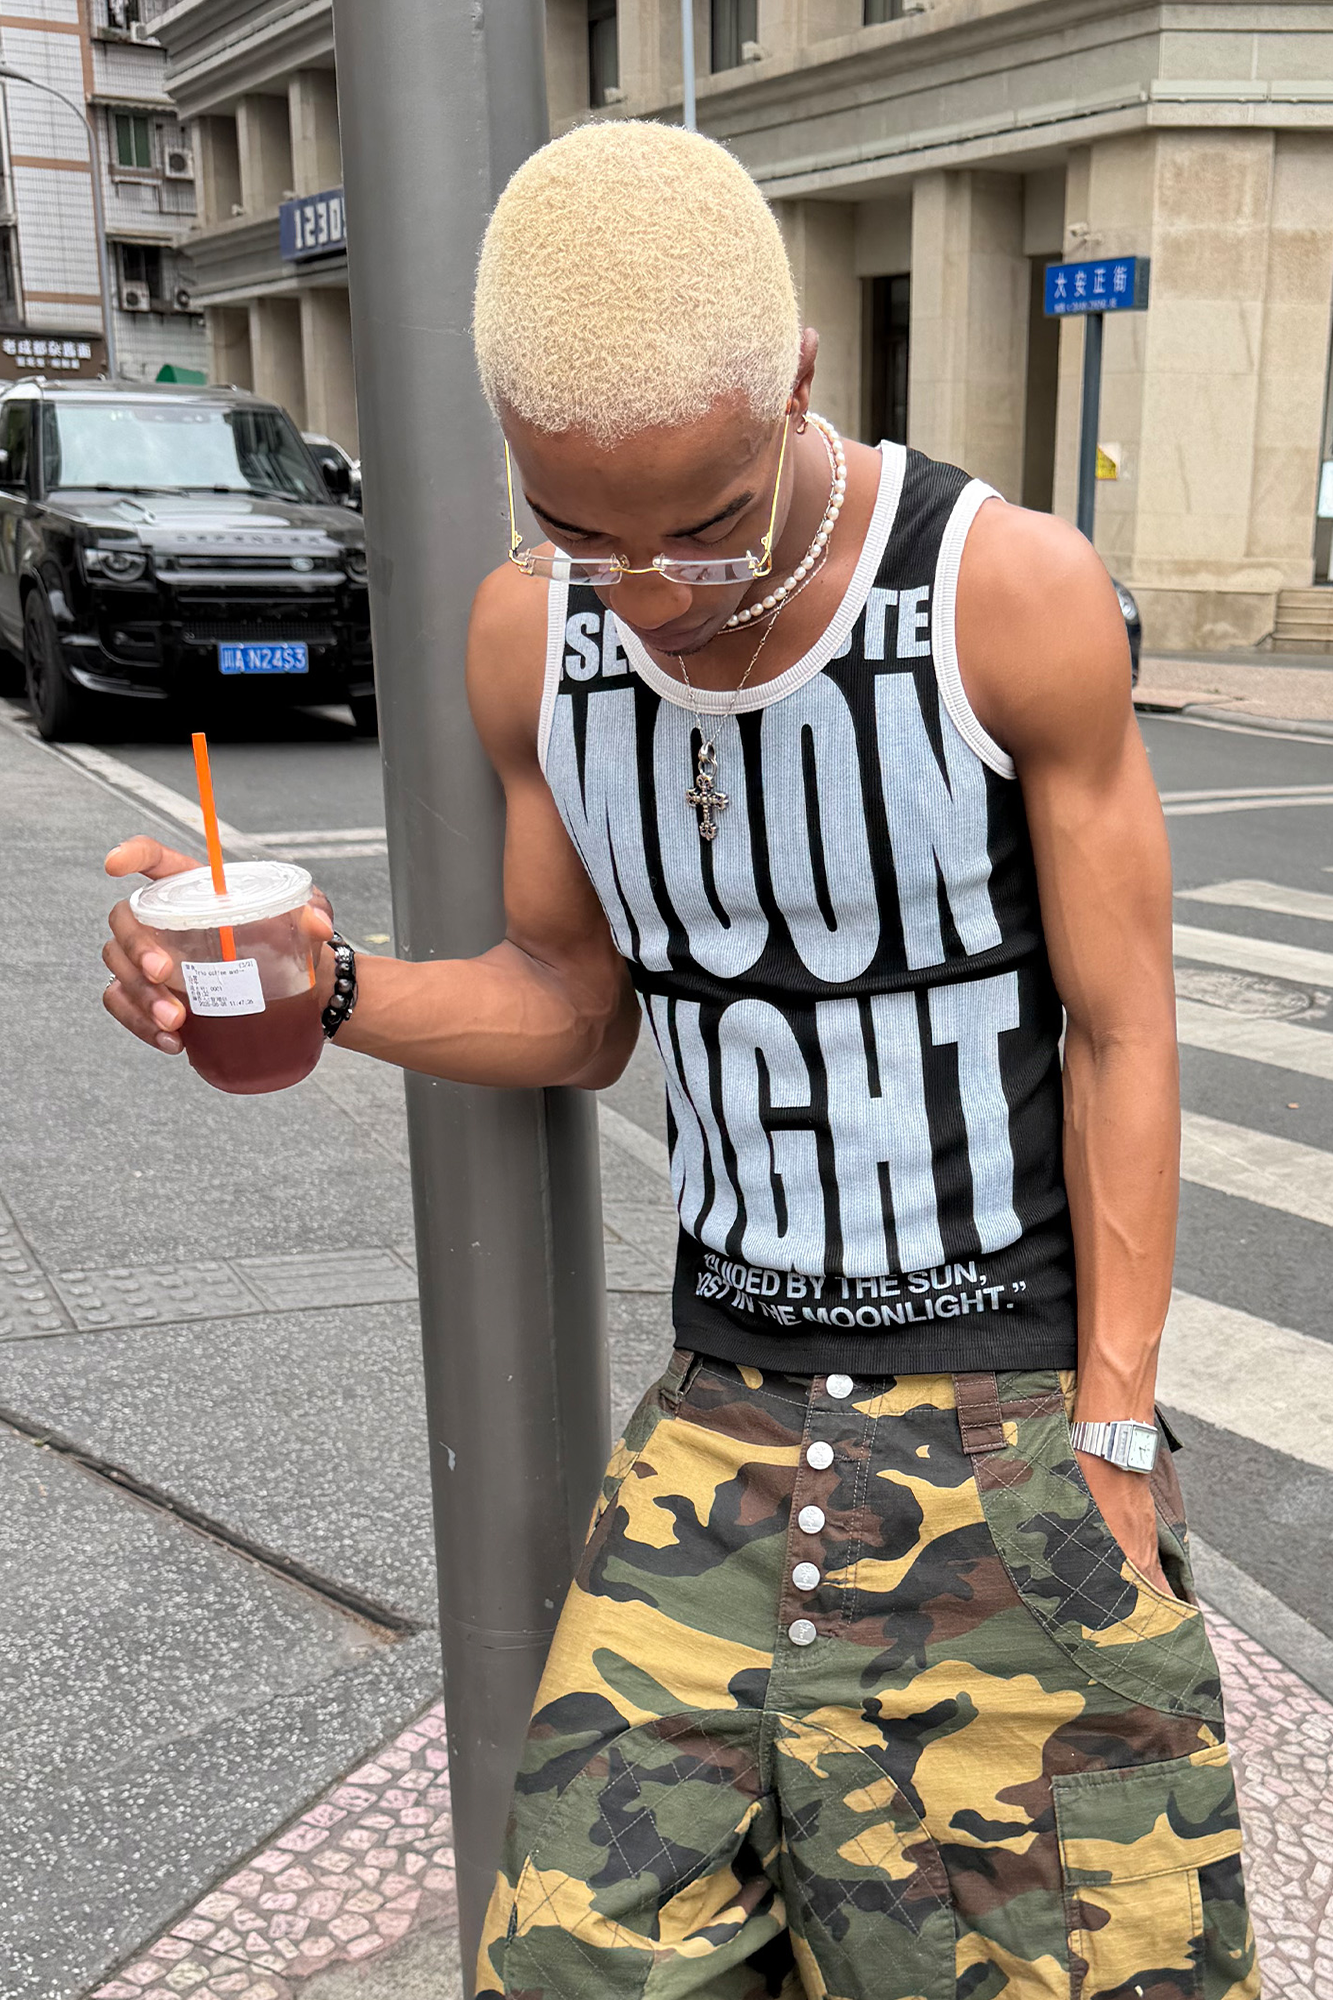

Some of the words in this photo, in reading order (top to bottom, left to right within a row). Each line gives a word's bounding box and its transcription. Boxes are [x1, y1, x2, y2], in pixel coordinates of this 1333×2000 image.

[294, 196, 346, 250] 1230
[1054, 265, 1128, 299] 大安正街
[545, 671, 1003, 983] MOON
[634, 971, 1023, 1278] NIGHT
[731, 1289, 754, 1313] IN
[786, 1272, 827, 1299] BY
[835, 1274, 900, 1299] THE
[908, 1260, 987, 1294] SUN,
